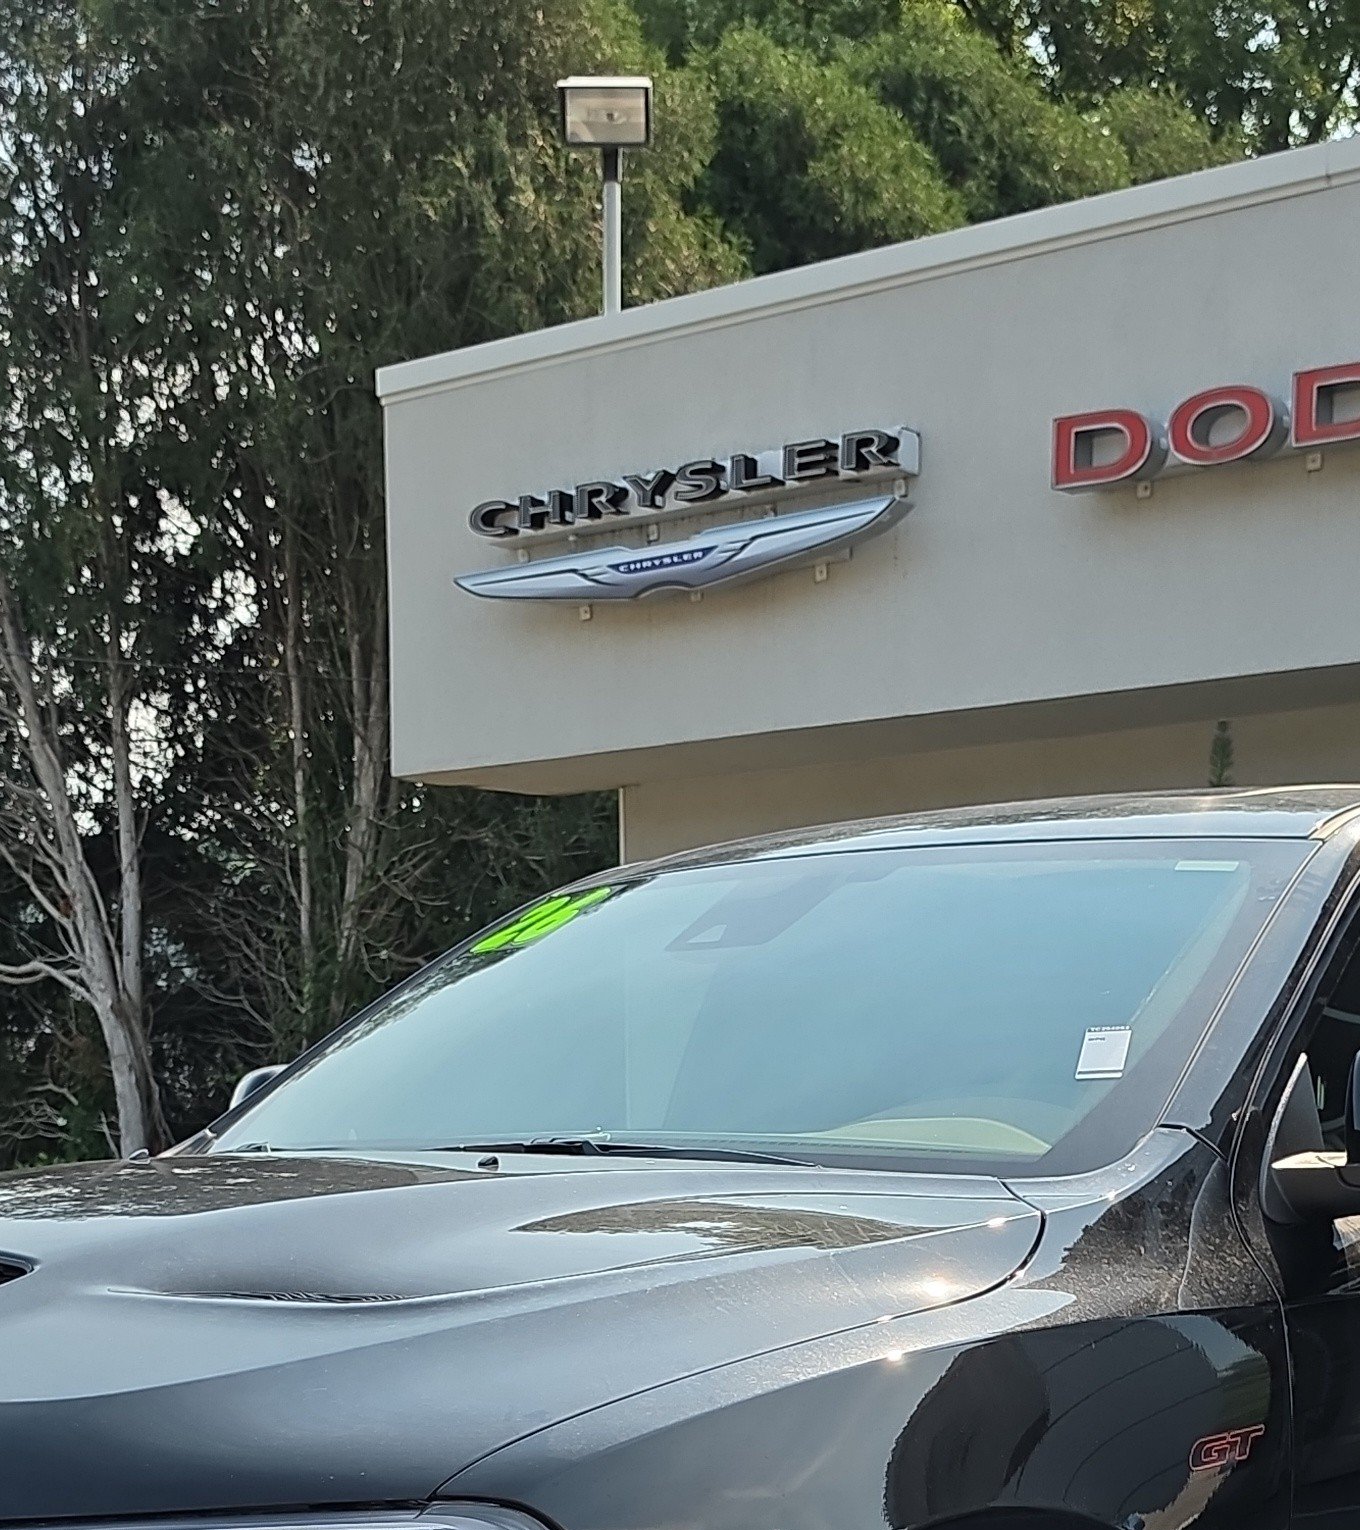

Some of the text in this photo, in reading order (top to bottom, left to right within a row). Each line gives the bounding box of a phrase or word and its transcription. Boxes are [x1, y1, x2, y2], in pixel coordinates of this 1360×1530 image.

[467, 427, 902, 539] CHRYSLER
[619, 551, 703, 572] CHRYSLER
[1189, 1423, 1266, 1471] GT
